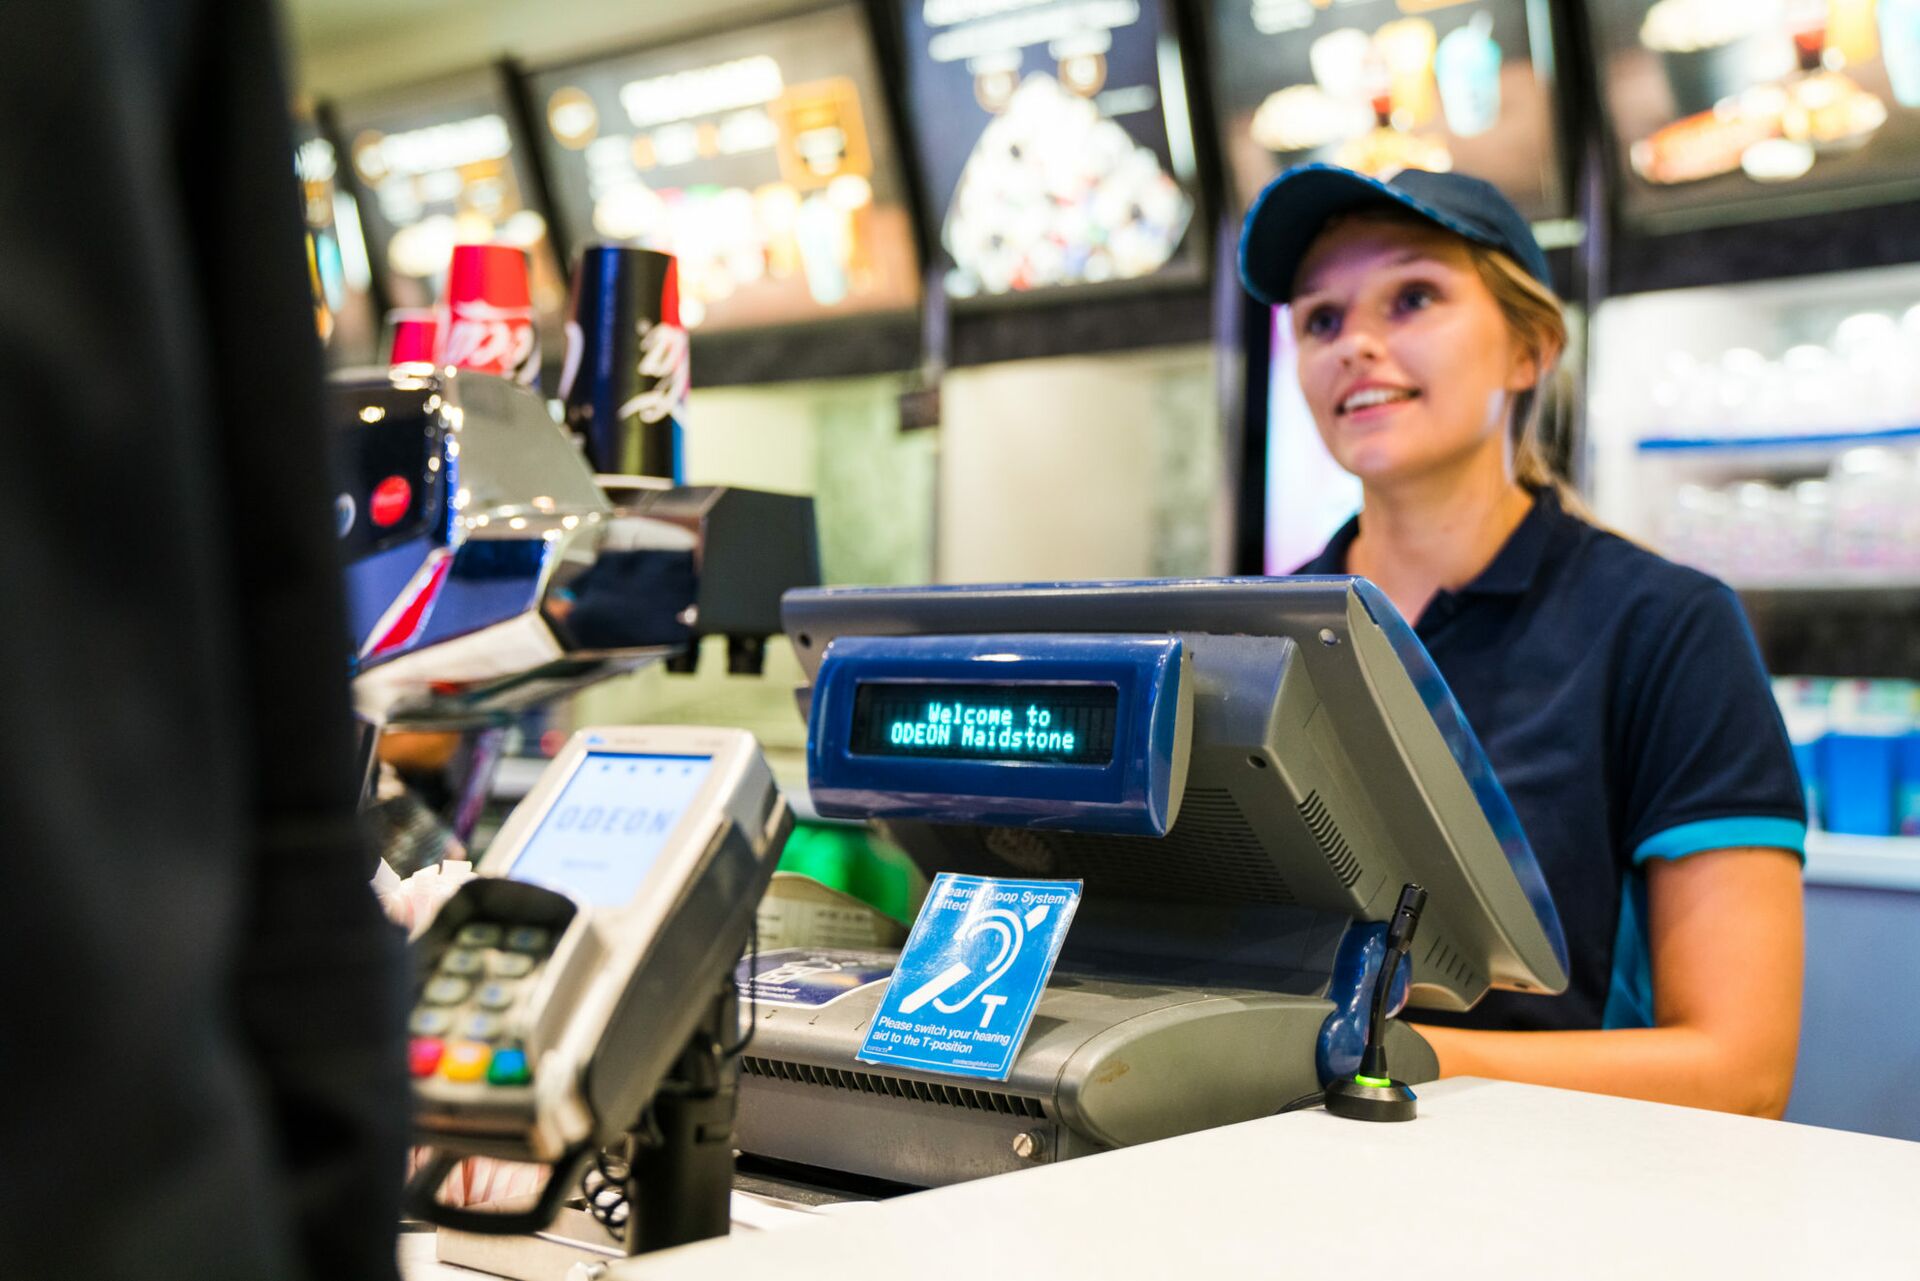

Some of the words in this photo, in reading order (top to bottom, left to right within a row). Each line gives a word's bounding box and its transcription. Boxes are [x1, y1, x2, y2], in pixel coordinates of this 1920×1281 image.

[929, 701, 1013, 726] Welcome
[1026, 704, 1052, 728] to
[890, 721, 951, 746] ODEON
[961, 723, 1076, 751] Maidstone
[933, 896, 970, 913] itted
[988, 889, 1019, 904] Loop
[1021, 891, 1067, 906] System
[981, 994, 1008, 1029] T
[872, 1030, 891, 1041] aid
[891, 1032, 902, 1044] to
[903, 1034, 920, 1046] the
[922, 1036, 973, 1054] T-position
[878, 1015, 913, 1031] Please
[914, 1023, 947, 1037] switch
[947, 1029, 972, 1041] your
[972, 1030, 1011, 1047] hearing
